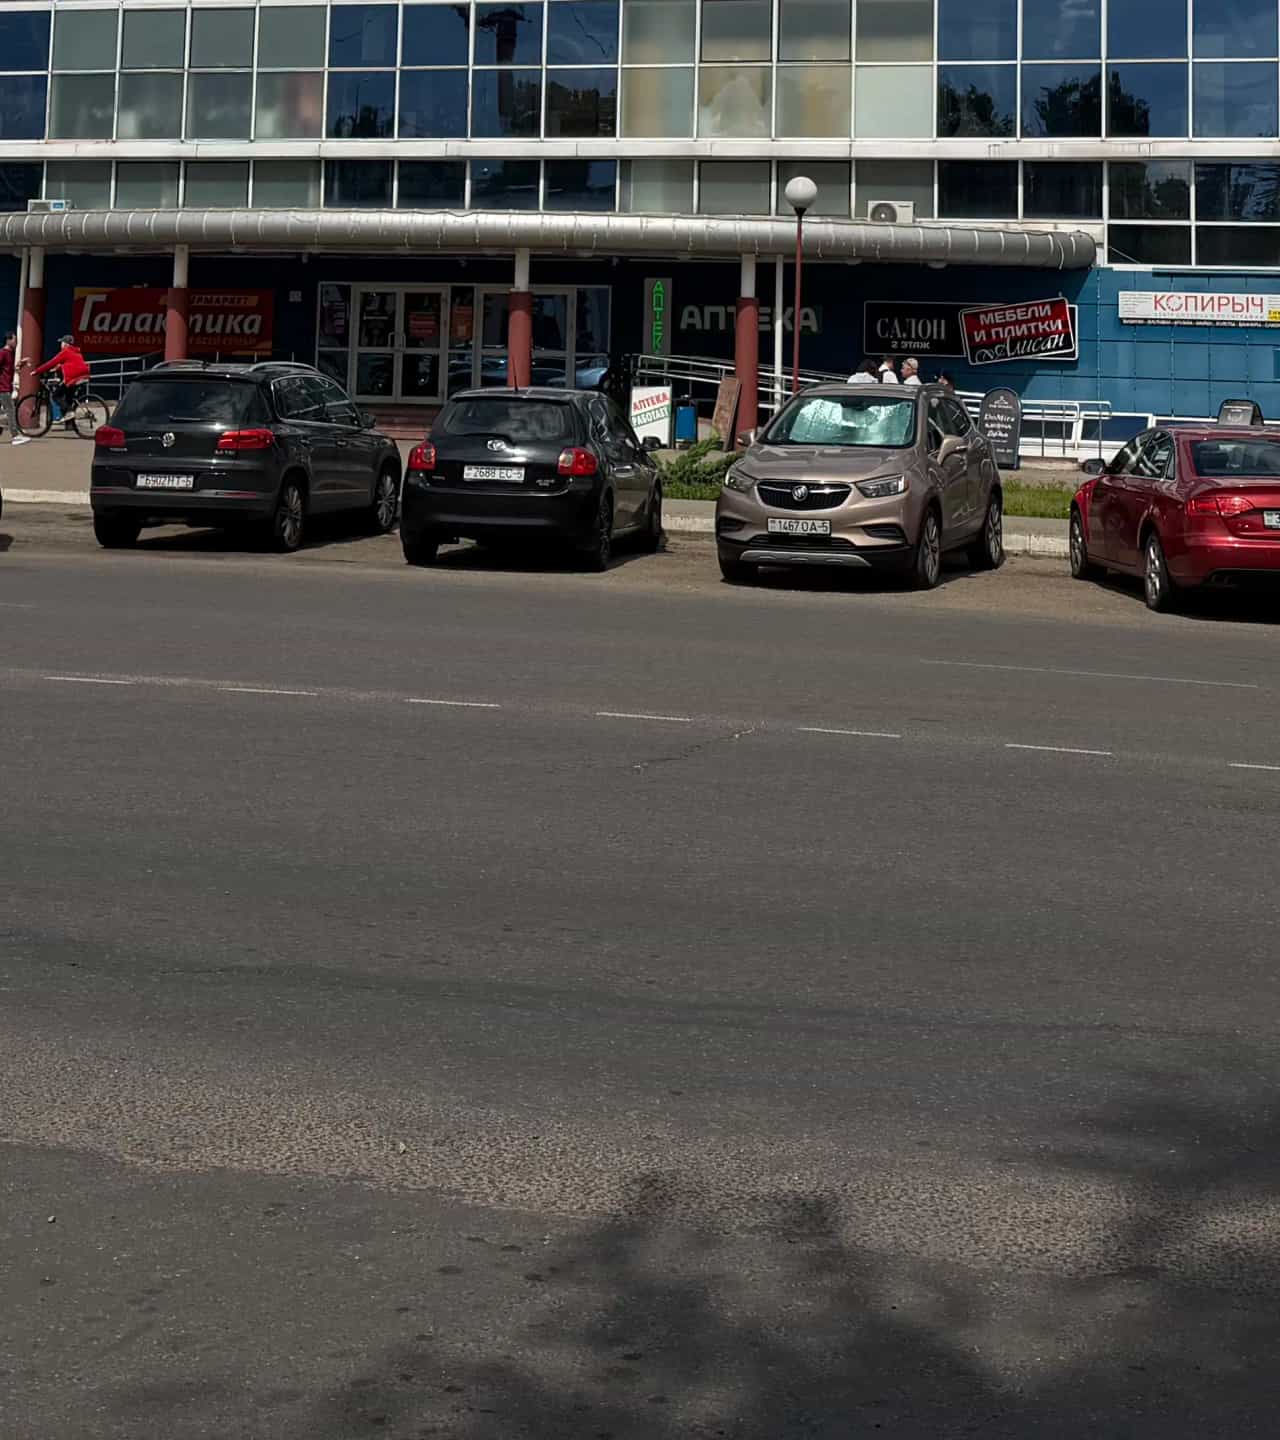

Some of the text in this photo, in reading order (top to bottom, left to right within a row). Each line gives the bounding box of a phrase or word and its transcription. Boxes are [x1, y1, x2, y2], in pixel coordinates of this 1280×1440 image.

[1153, 294, 1264, 314] КОПИРЫЧ
[979, 304, 1052, 326] МЕБЕЛИ
[876, 317, 946, 340] САЛОН
[974, 319, 1063, 342] И ПЛИТКИ
[632, 391, 669, 412] АПТЕКА
[778, 520, 828, 533] 1467 OA-5
